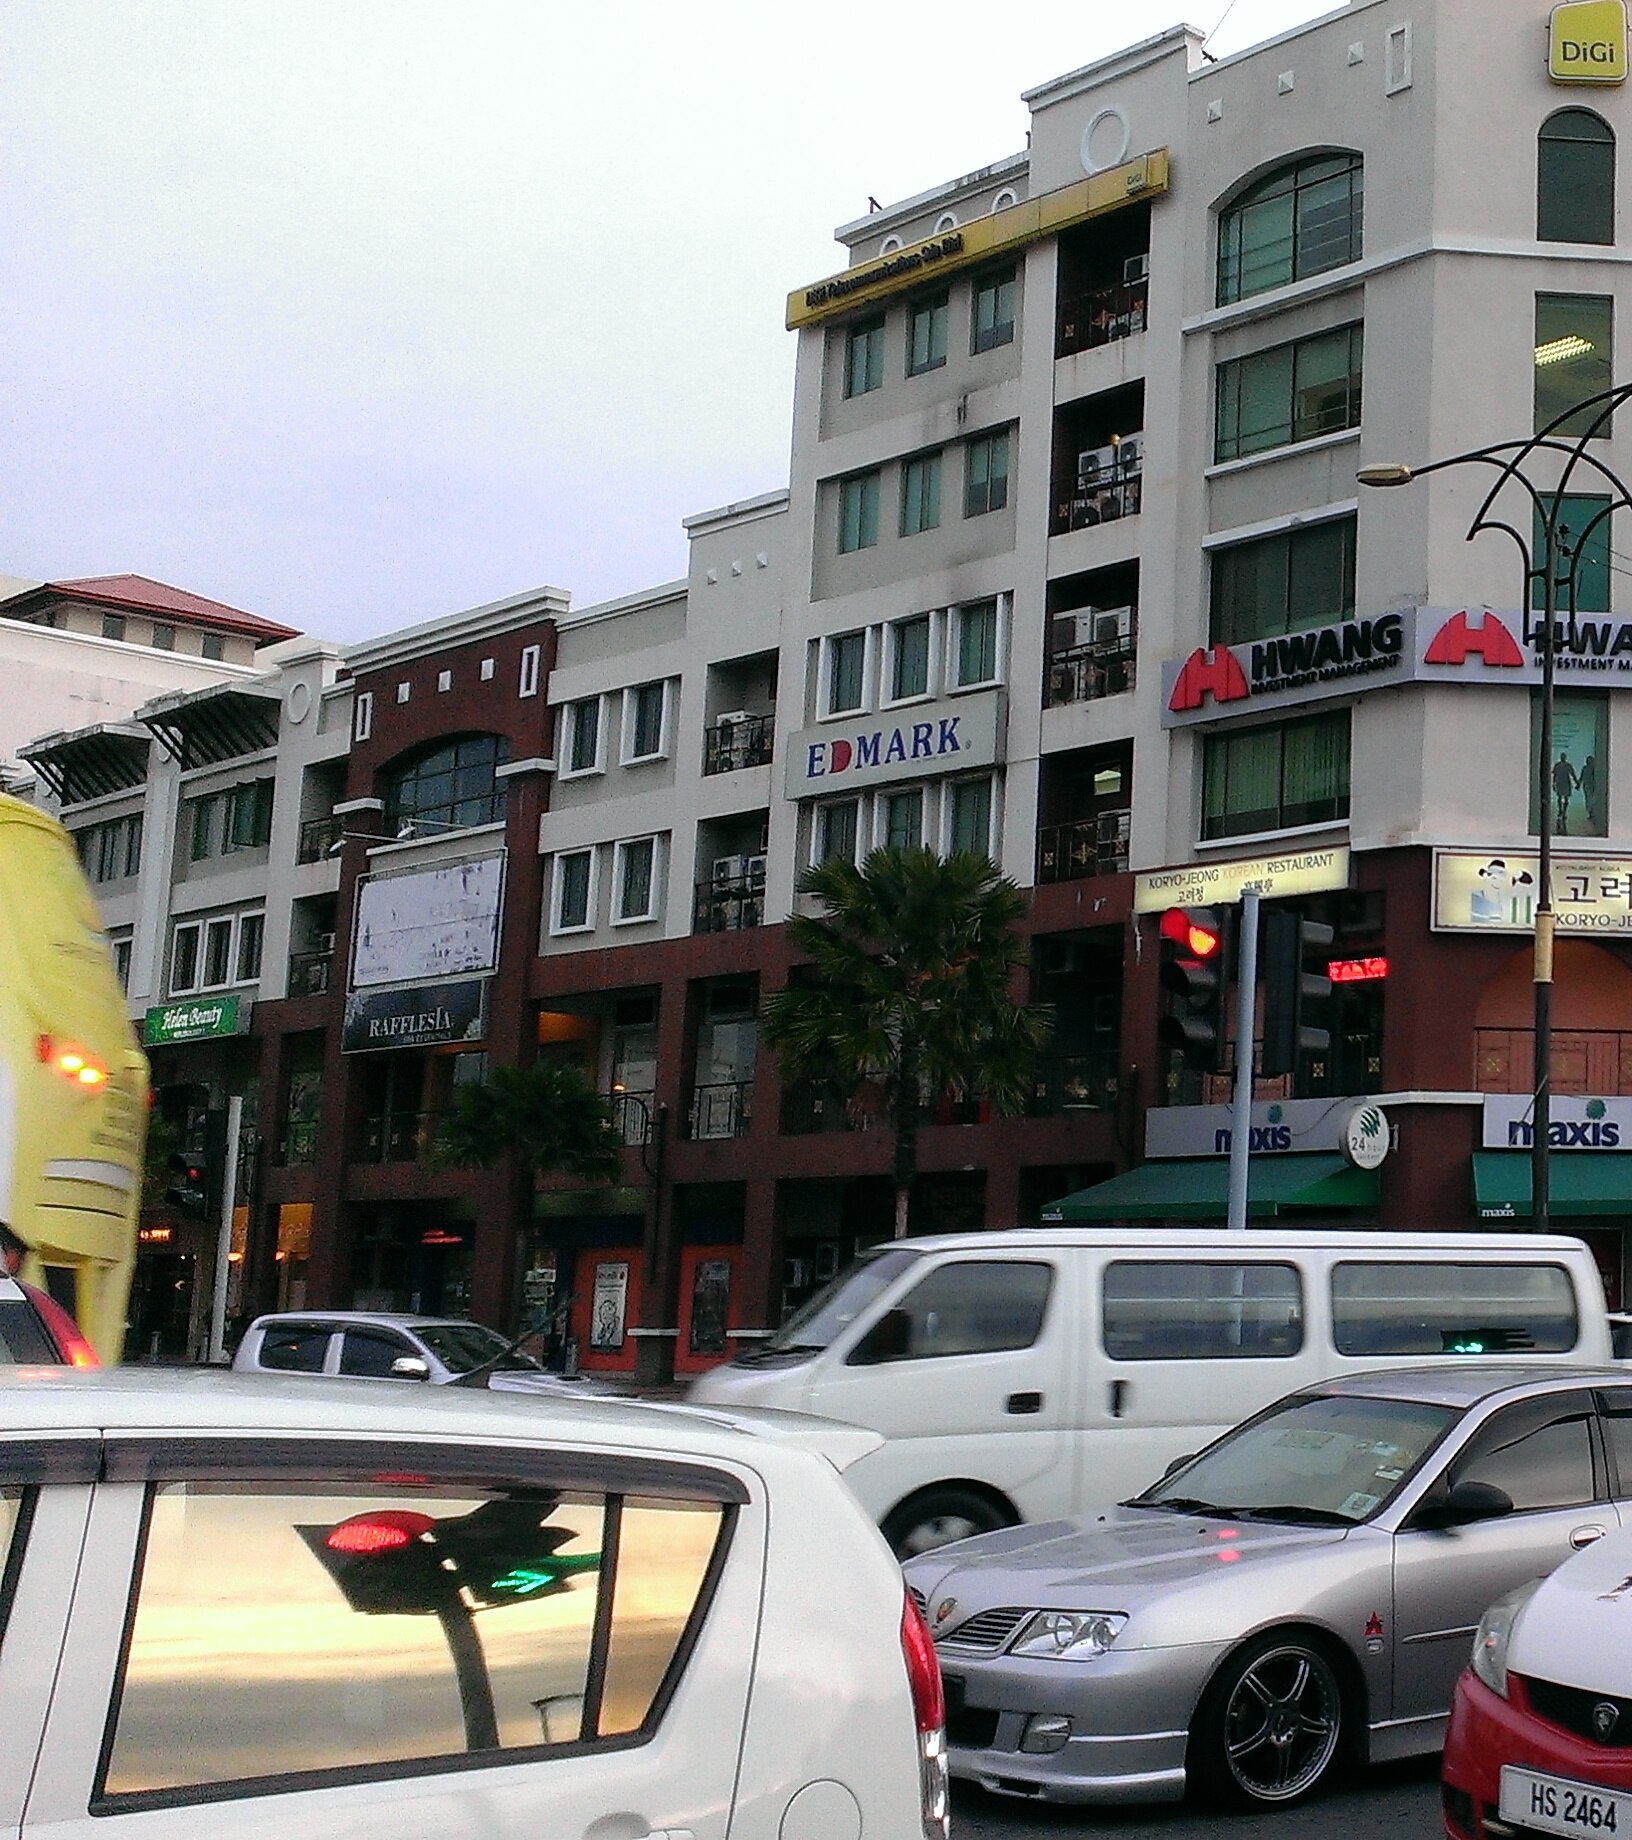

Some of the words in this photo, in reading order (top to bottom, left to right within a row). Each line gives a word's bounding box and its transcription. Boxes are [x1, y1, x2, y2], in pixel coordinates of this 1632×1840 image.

[1562, 41, 1614, 63] DiGi
[1251, 614, 1403, 681] HWANG
[1319, 653, 1402, 681] MANAGEMENT
[806, 716, 961, 778] EDMARK
[1148, 869, 1219, 890] KORYO-JEONG
[1222, 864, 1265, 879] KOREAN
[1267, 854, 1334, 874] RESTAURANT
[161, 1007, 188, 1030] Helen
[189, 1006, 223, 1029] Beauty
[368, 1005, 452, 1037] RAFFLESIA
[1351, 1136, 1366, 1152] 24
[1481, 1203, 1516, 1217] maxis
[1531, 1782, 1557, 1817] HS
[1564, 1791, 1617, 1832] 2464
